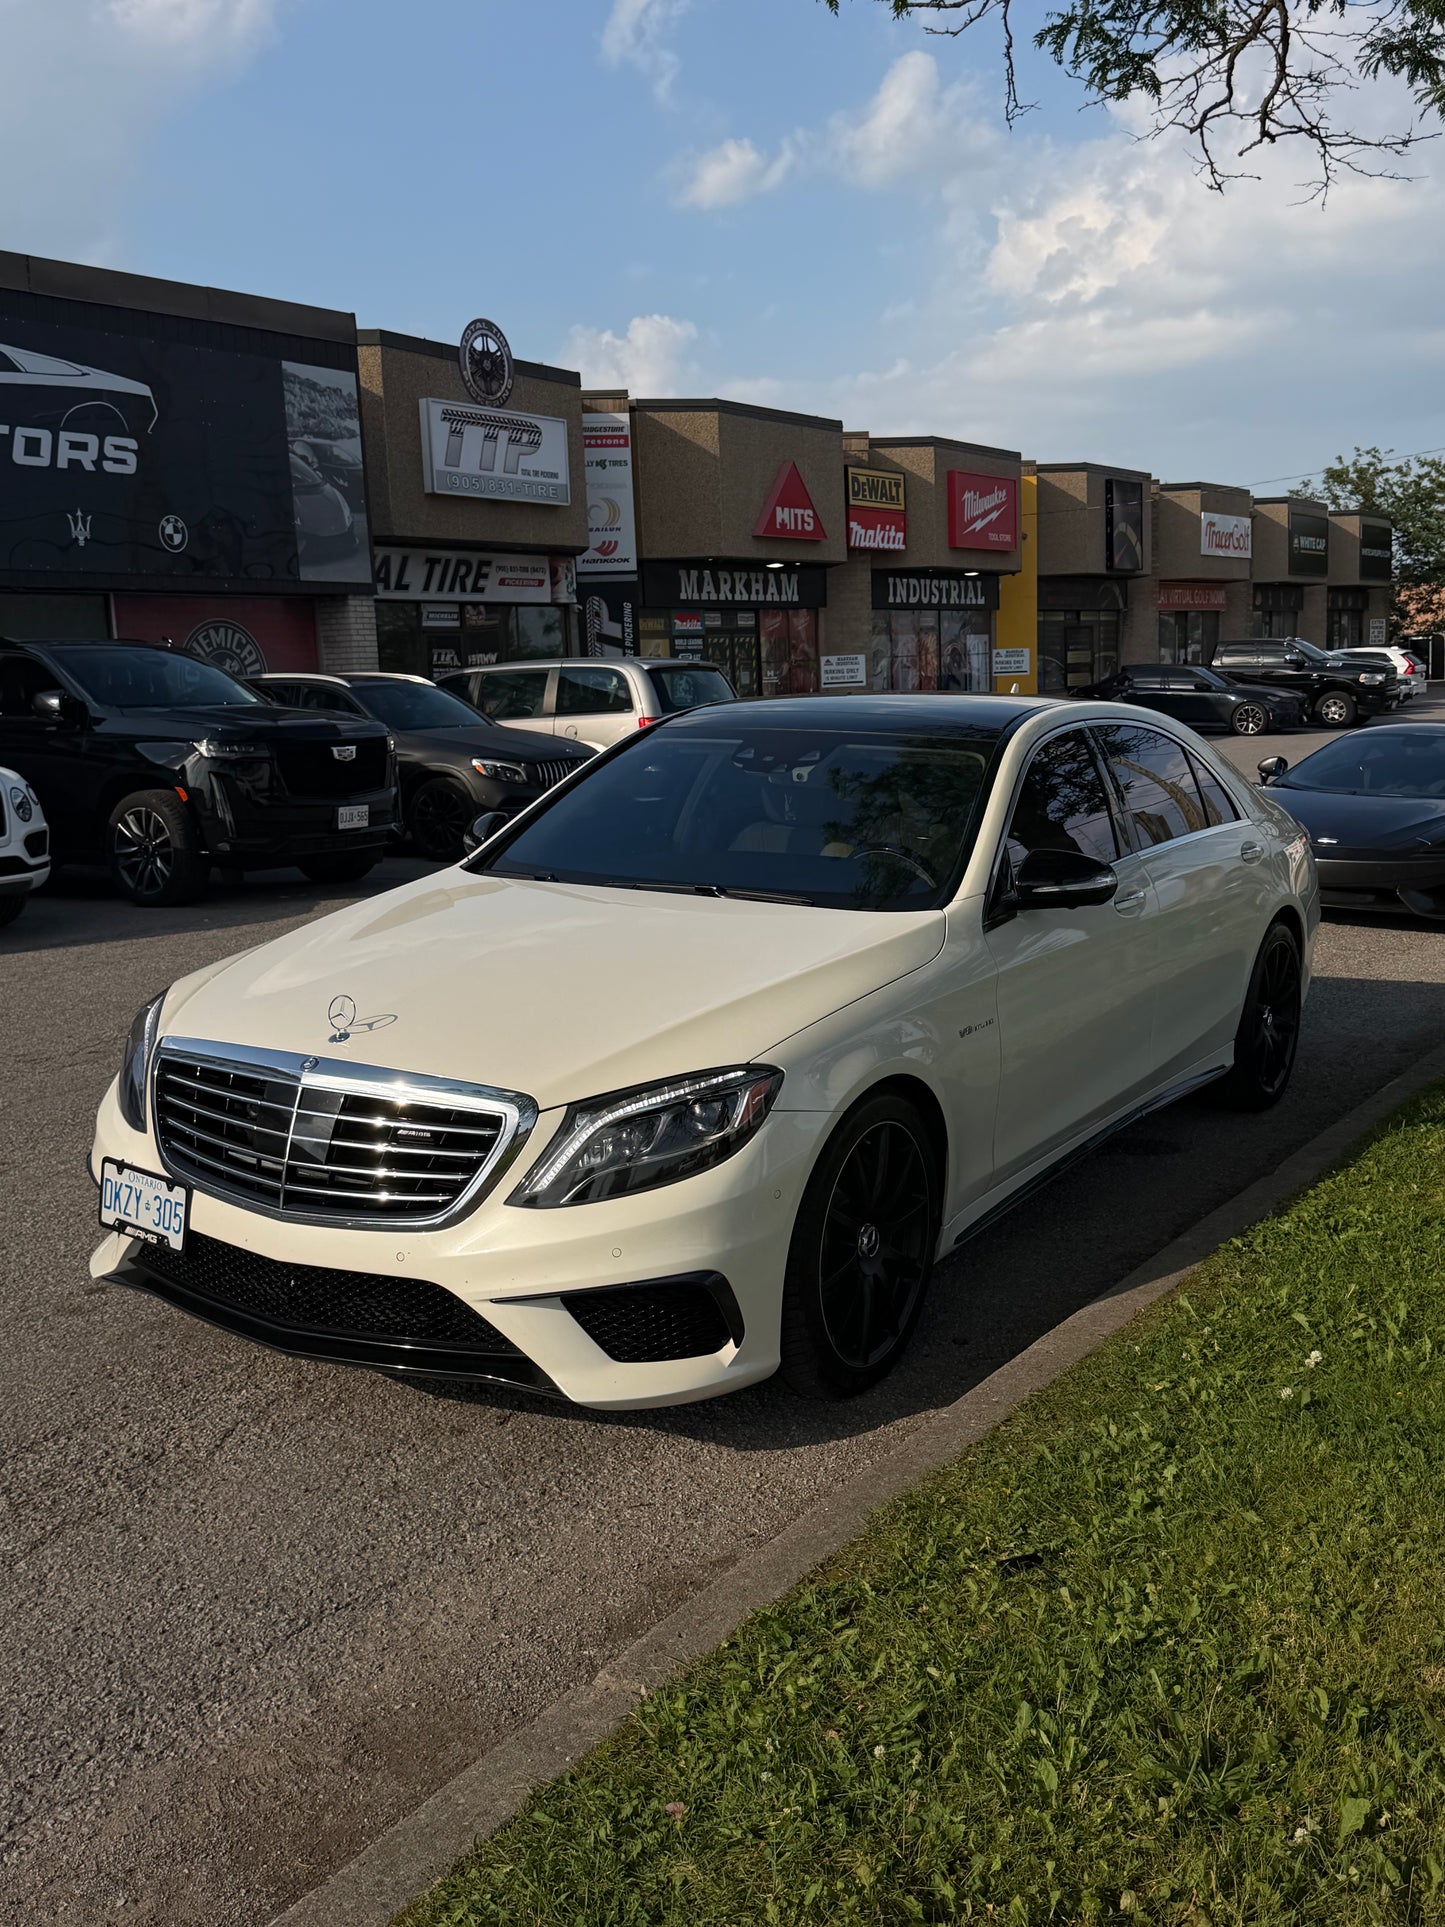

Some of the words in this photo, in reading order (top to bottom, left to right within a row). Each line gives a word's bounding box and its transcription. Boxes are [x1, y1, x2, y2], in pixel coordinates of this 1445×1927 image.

[463, 321, 488, 346] TOTAL
[0, 424, 139, 475] ORS
[441, 408, 543, 474] TTP
[608, 459, 628, 467] TIRES
[775, 506, 814, 531] MITS
[961, 485, 1008, 523] Milwaukee
[422, 557, 493, 593] TIRE
[679, 569, 800, 602] MARKHAM
[887, 576, 986, 605] INDUSTRIAL
[622, 601, 634, 648] PICKERING
[103, 1177, 142, 1220] DKZY
[152, 1195, 183, 1234] 305
[135, 1230, 158, 1244] AMG
